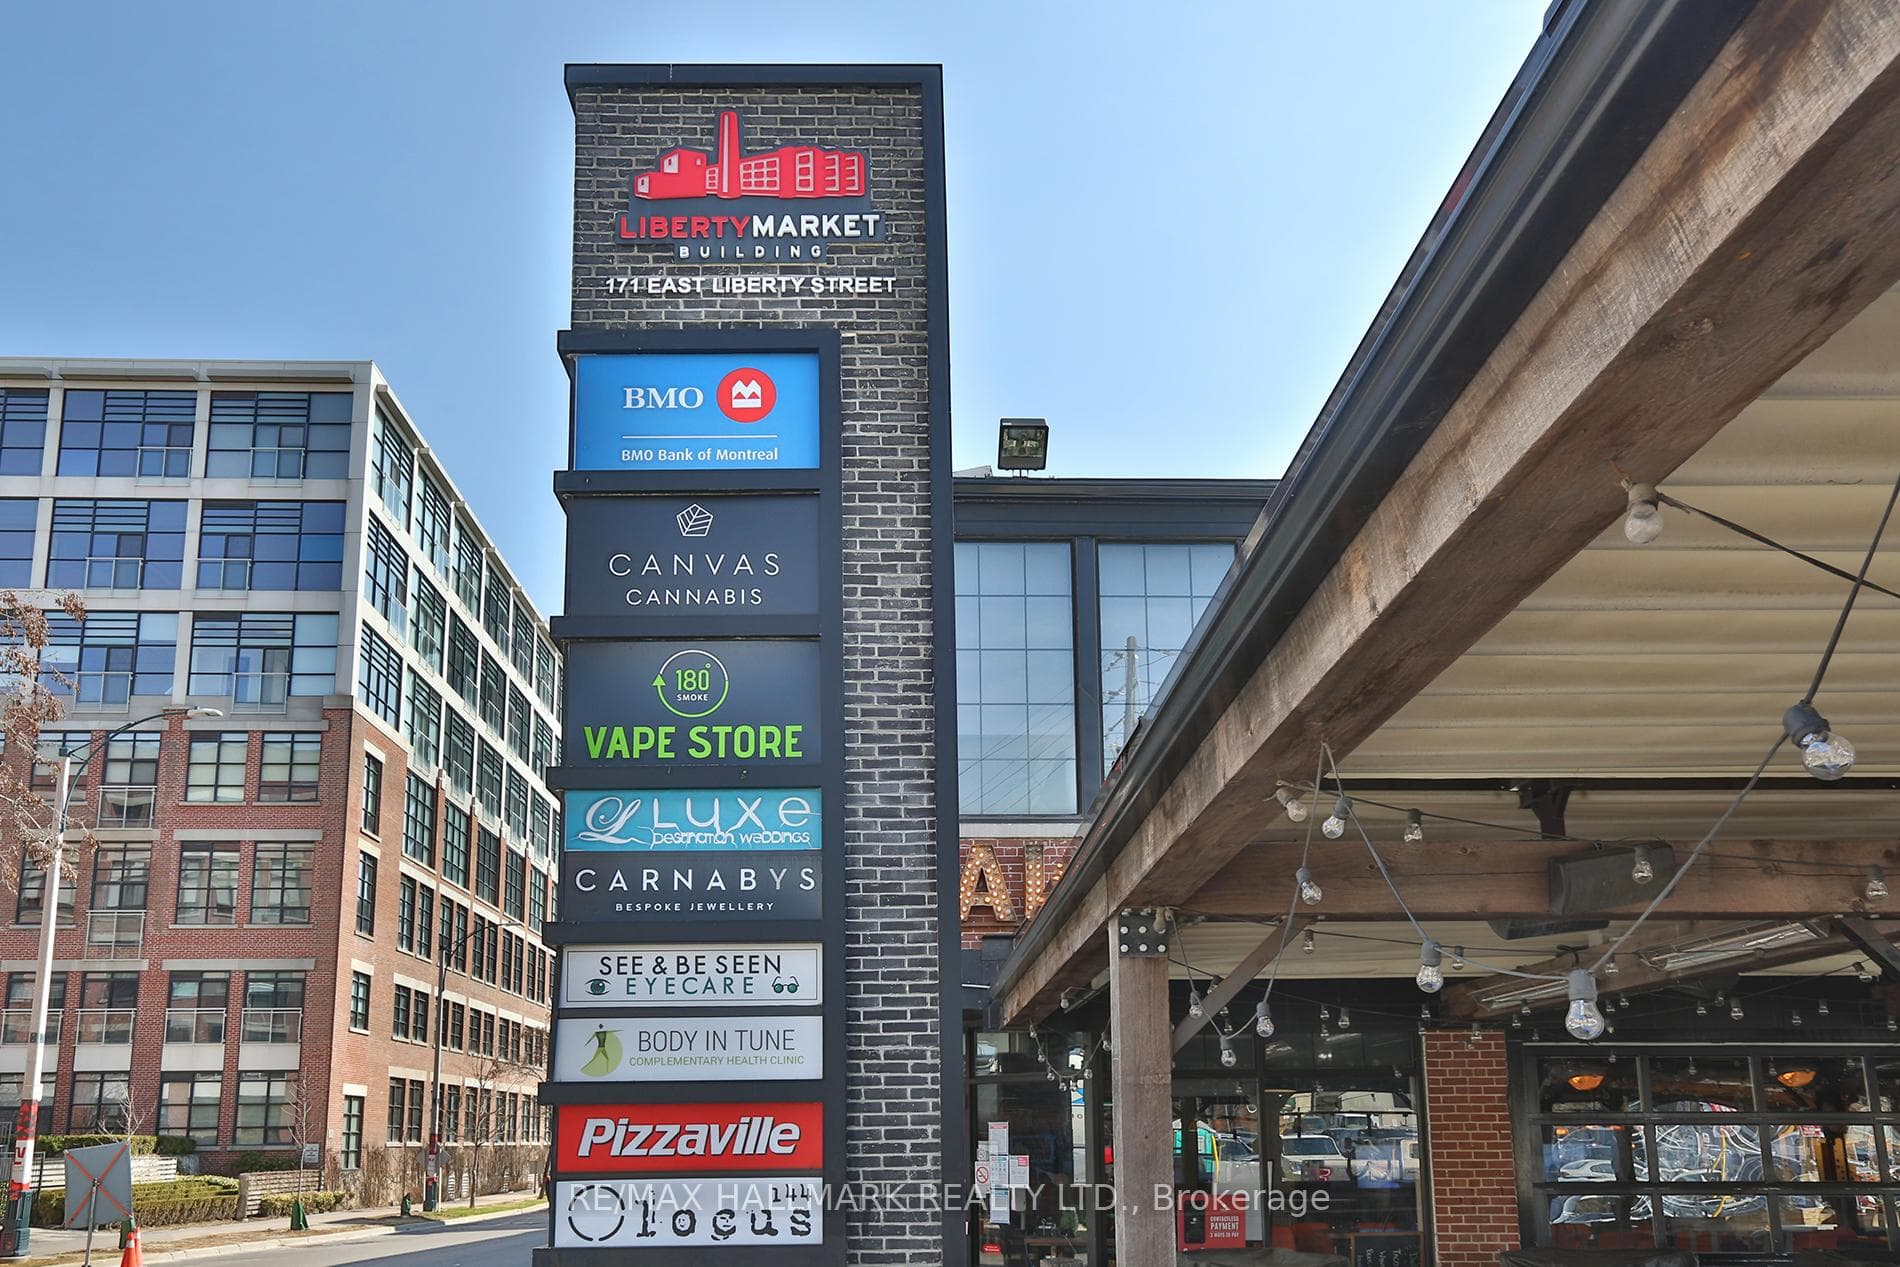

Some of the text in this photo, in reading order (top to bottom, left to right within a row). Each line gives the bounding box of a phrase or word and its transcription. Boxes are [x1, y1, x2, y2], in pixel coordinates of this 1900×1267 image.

[679, 245, 823, 259] BUILDING
[605, 276, 897, 294] 171 EAST LIBERTY STREET
[622, 386, 704, 409] BMO
[621, 447, 778, 462] BMO Bank of Montreal
[608, 553, 781, 577] CANVAS
[625, 588, 763, 605] CANNABIS
[676, 693, 709, 702] SMOKE
[583, 725, 803, 760] VAPE STORE
[574, 867, 816, 893] CARNABYS
[615, 902, 775, 912] BESPOKE JEWELLERY
[599, 955, 782, 976] SEE & BE SEEN
[625, 976, 755, 995] EYECARE
[638, 1029, 795, 1052] BODY IN TUNE
[628, 1055, 805, 1067] COMPLEMENTARY HEALTH CLINIC
[576, 1116, 801, 1158] Pizzaville
[1210, 1222, 1239, 1231] PAYMENT
